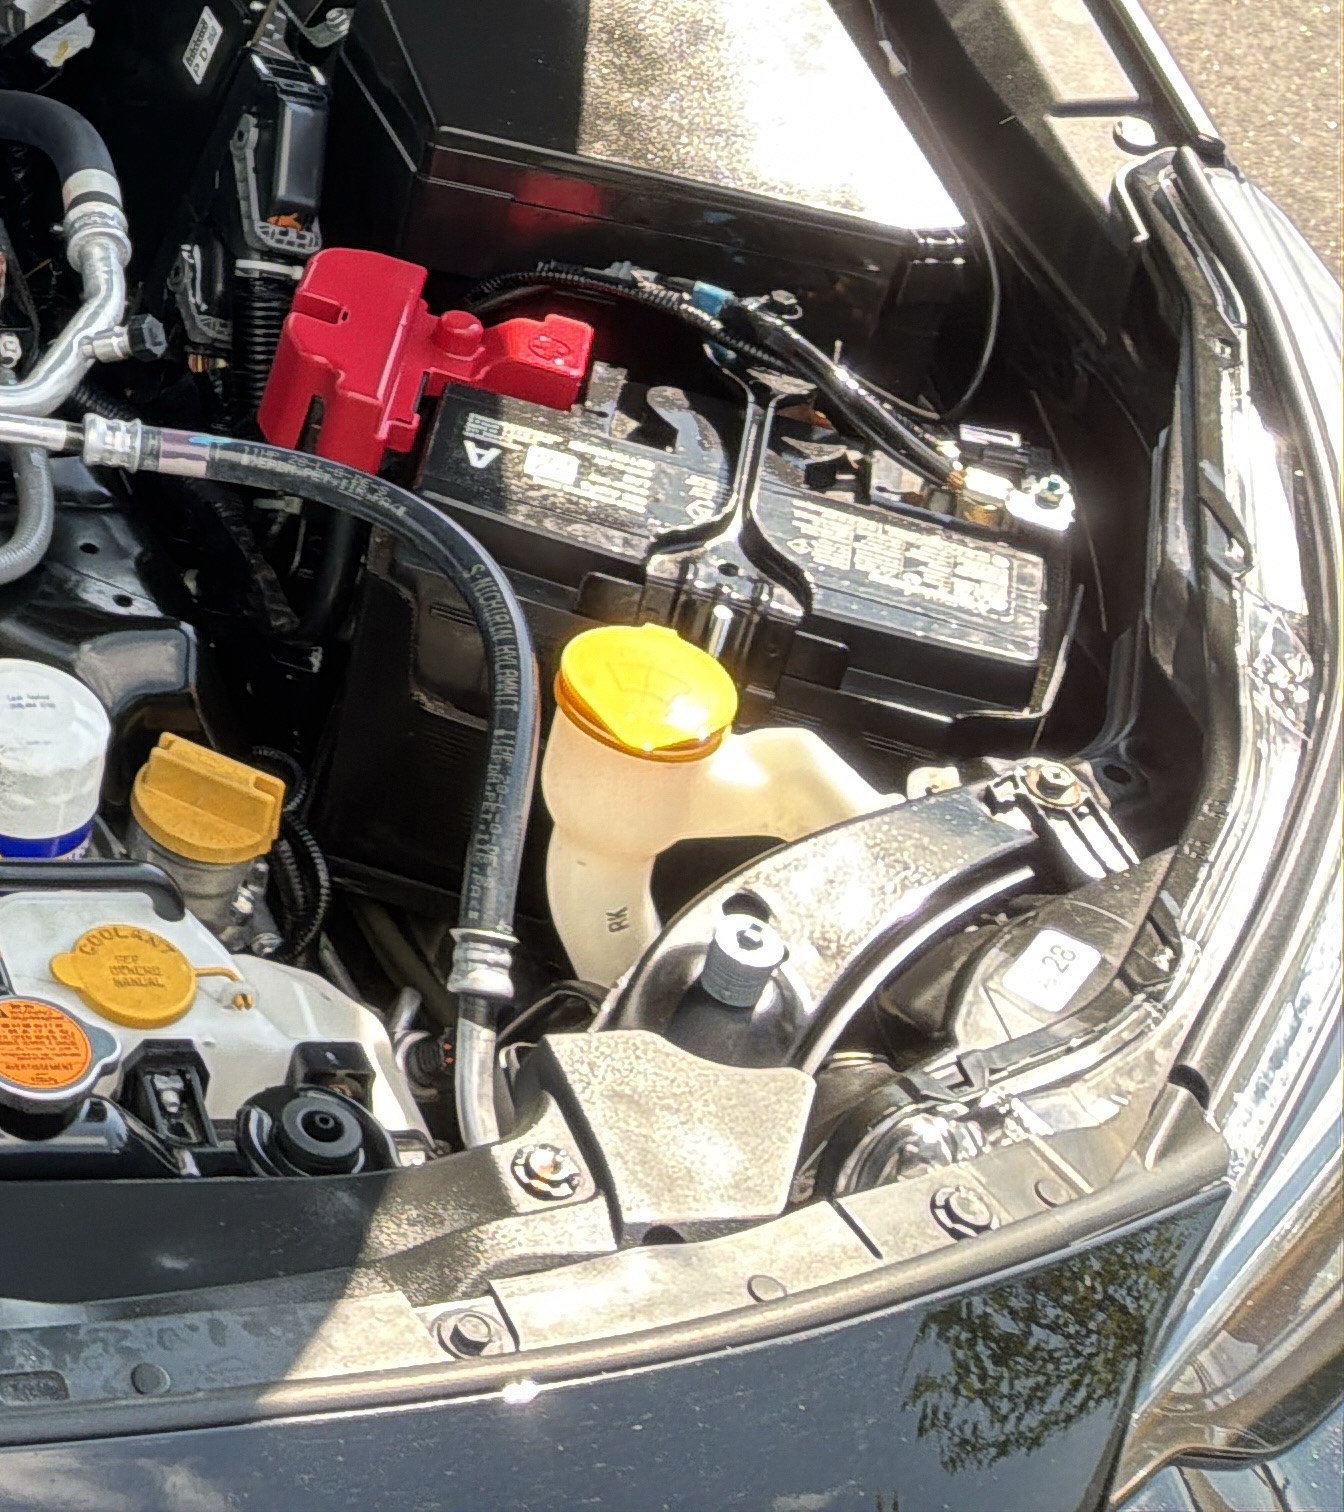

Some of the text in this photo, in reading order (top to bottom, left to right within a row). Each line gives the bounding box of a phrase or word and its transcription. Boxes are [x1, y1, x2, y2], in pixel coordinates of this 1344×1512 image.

[605, 906, 630, 933] RK
[79, 928, 177, 955] COOLANT
[1041, 944, 1076, 974] 28
